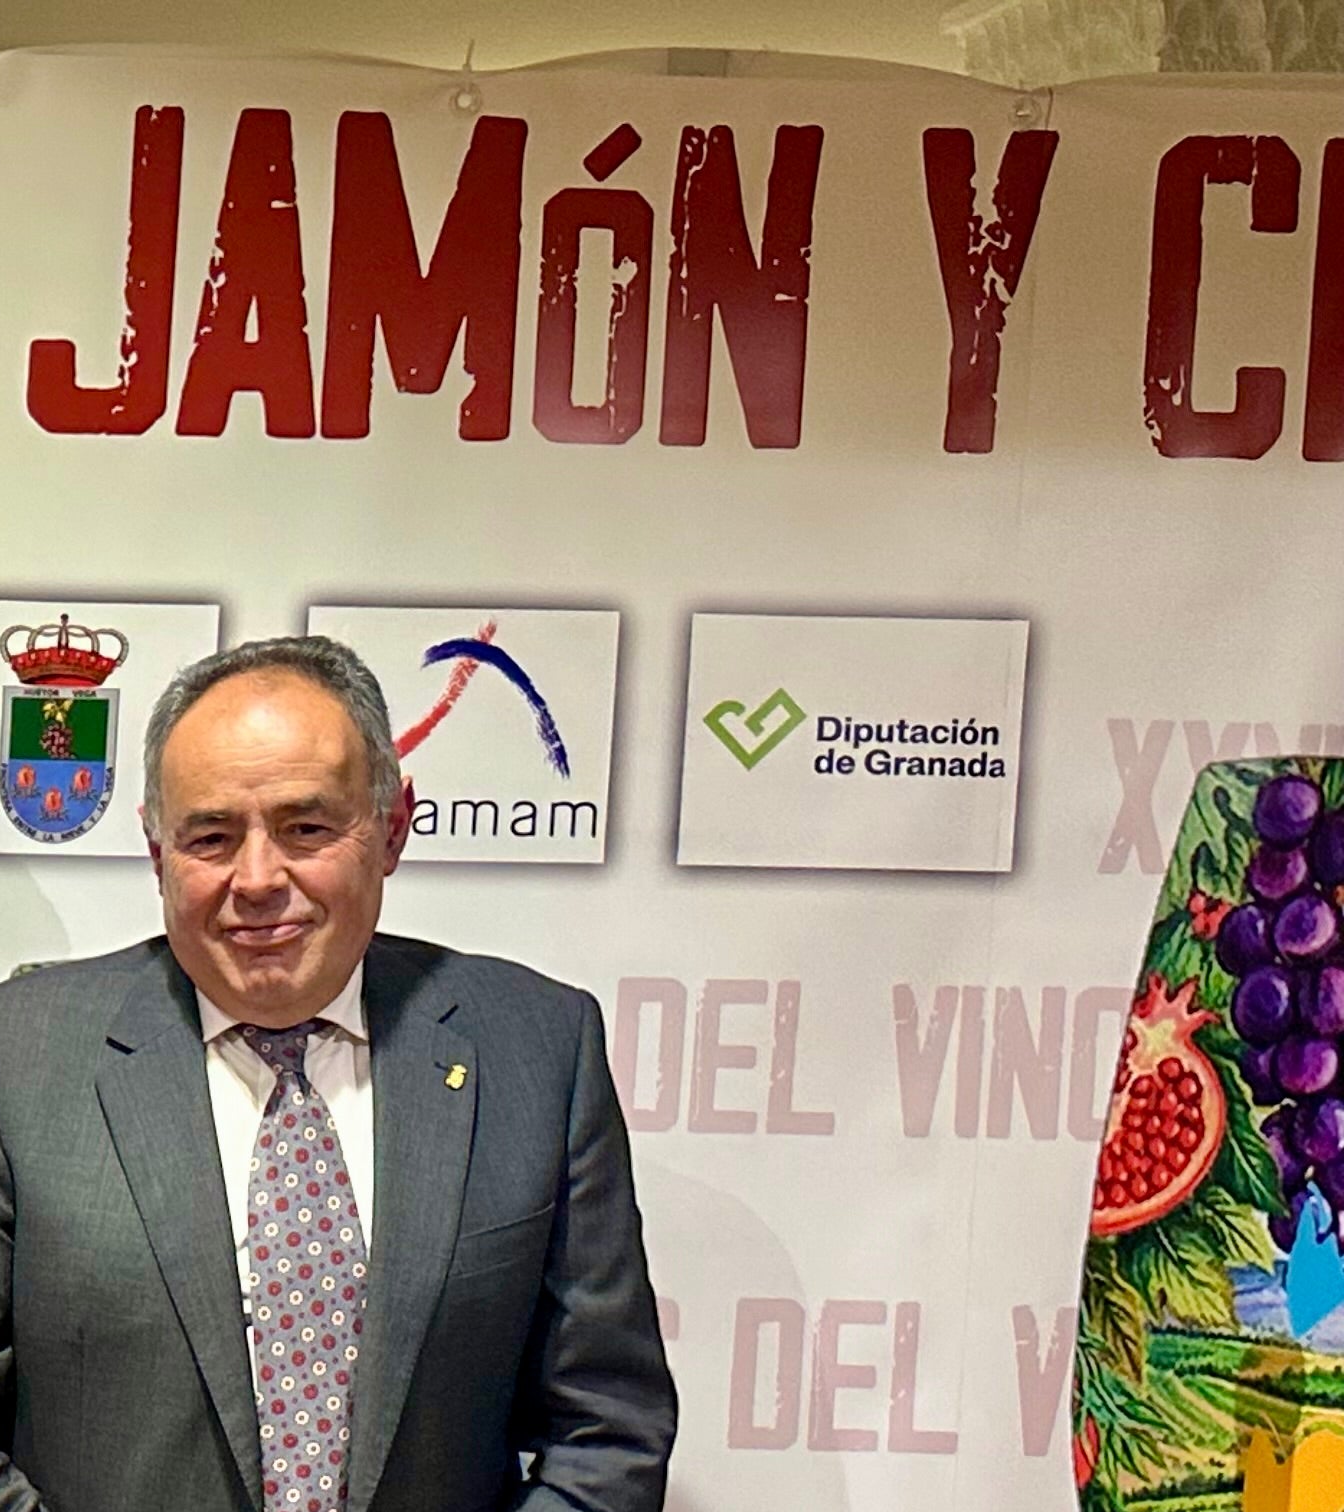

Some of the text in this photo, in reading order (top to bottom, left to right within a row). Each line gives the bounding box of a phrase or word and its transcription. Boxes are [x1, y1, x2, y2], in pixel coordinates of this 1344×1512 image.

[26, 105, 824, 450] JAMÓN
[922, 127, 1060, 454] Y
[813, 751, 1007, 780] de Granada
[815, 715, 1000, 748] Diputación
[614, 977, 835, 1136] DEL
[728, 1297, 959, 1454] DEL
